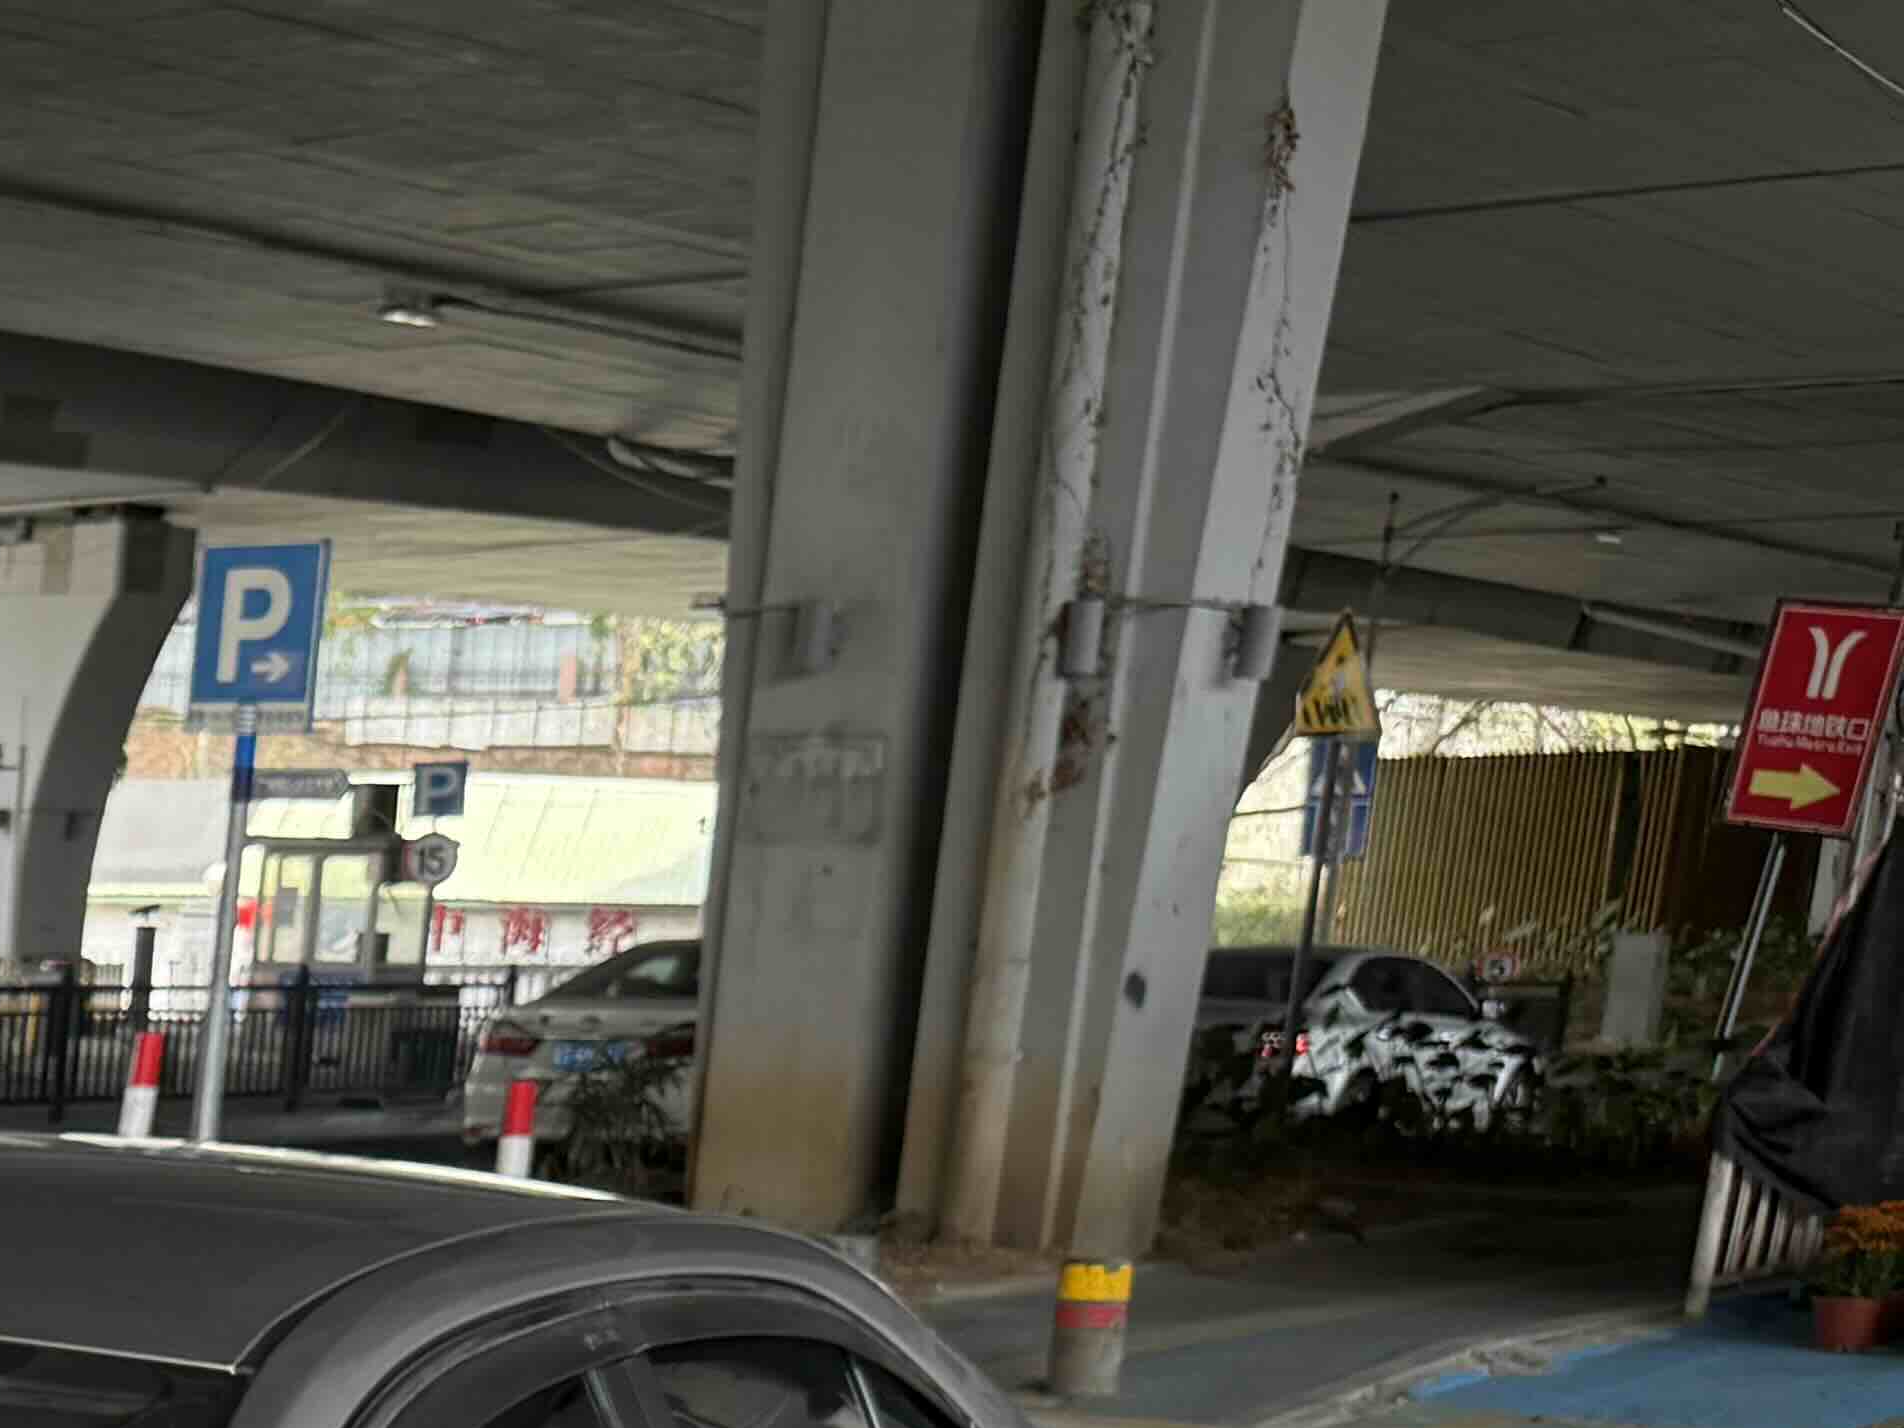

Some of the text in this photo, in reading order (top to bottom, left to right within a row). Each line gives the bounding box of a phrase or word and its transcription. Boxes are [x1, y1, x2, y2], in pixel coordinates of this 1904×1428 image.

[217, 567, 291, 683] P
[421, 767, 459, 810] P
[415, 845, 446, 876] 15
